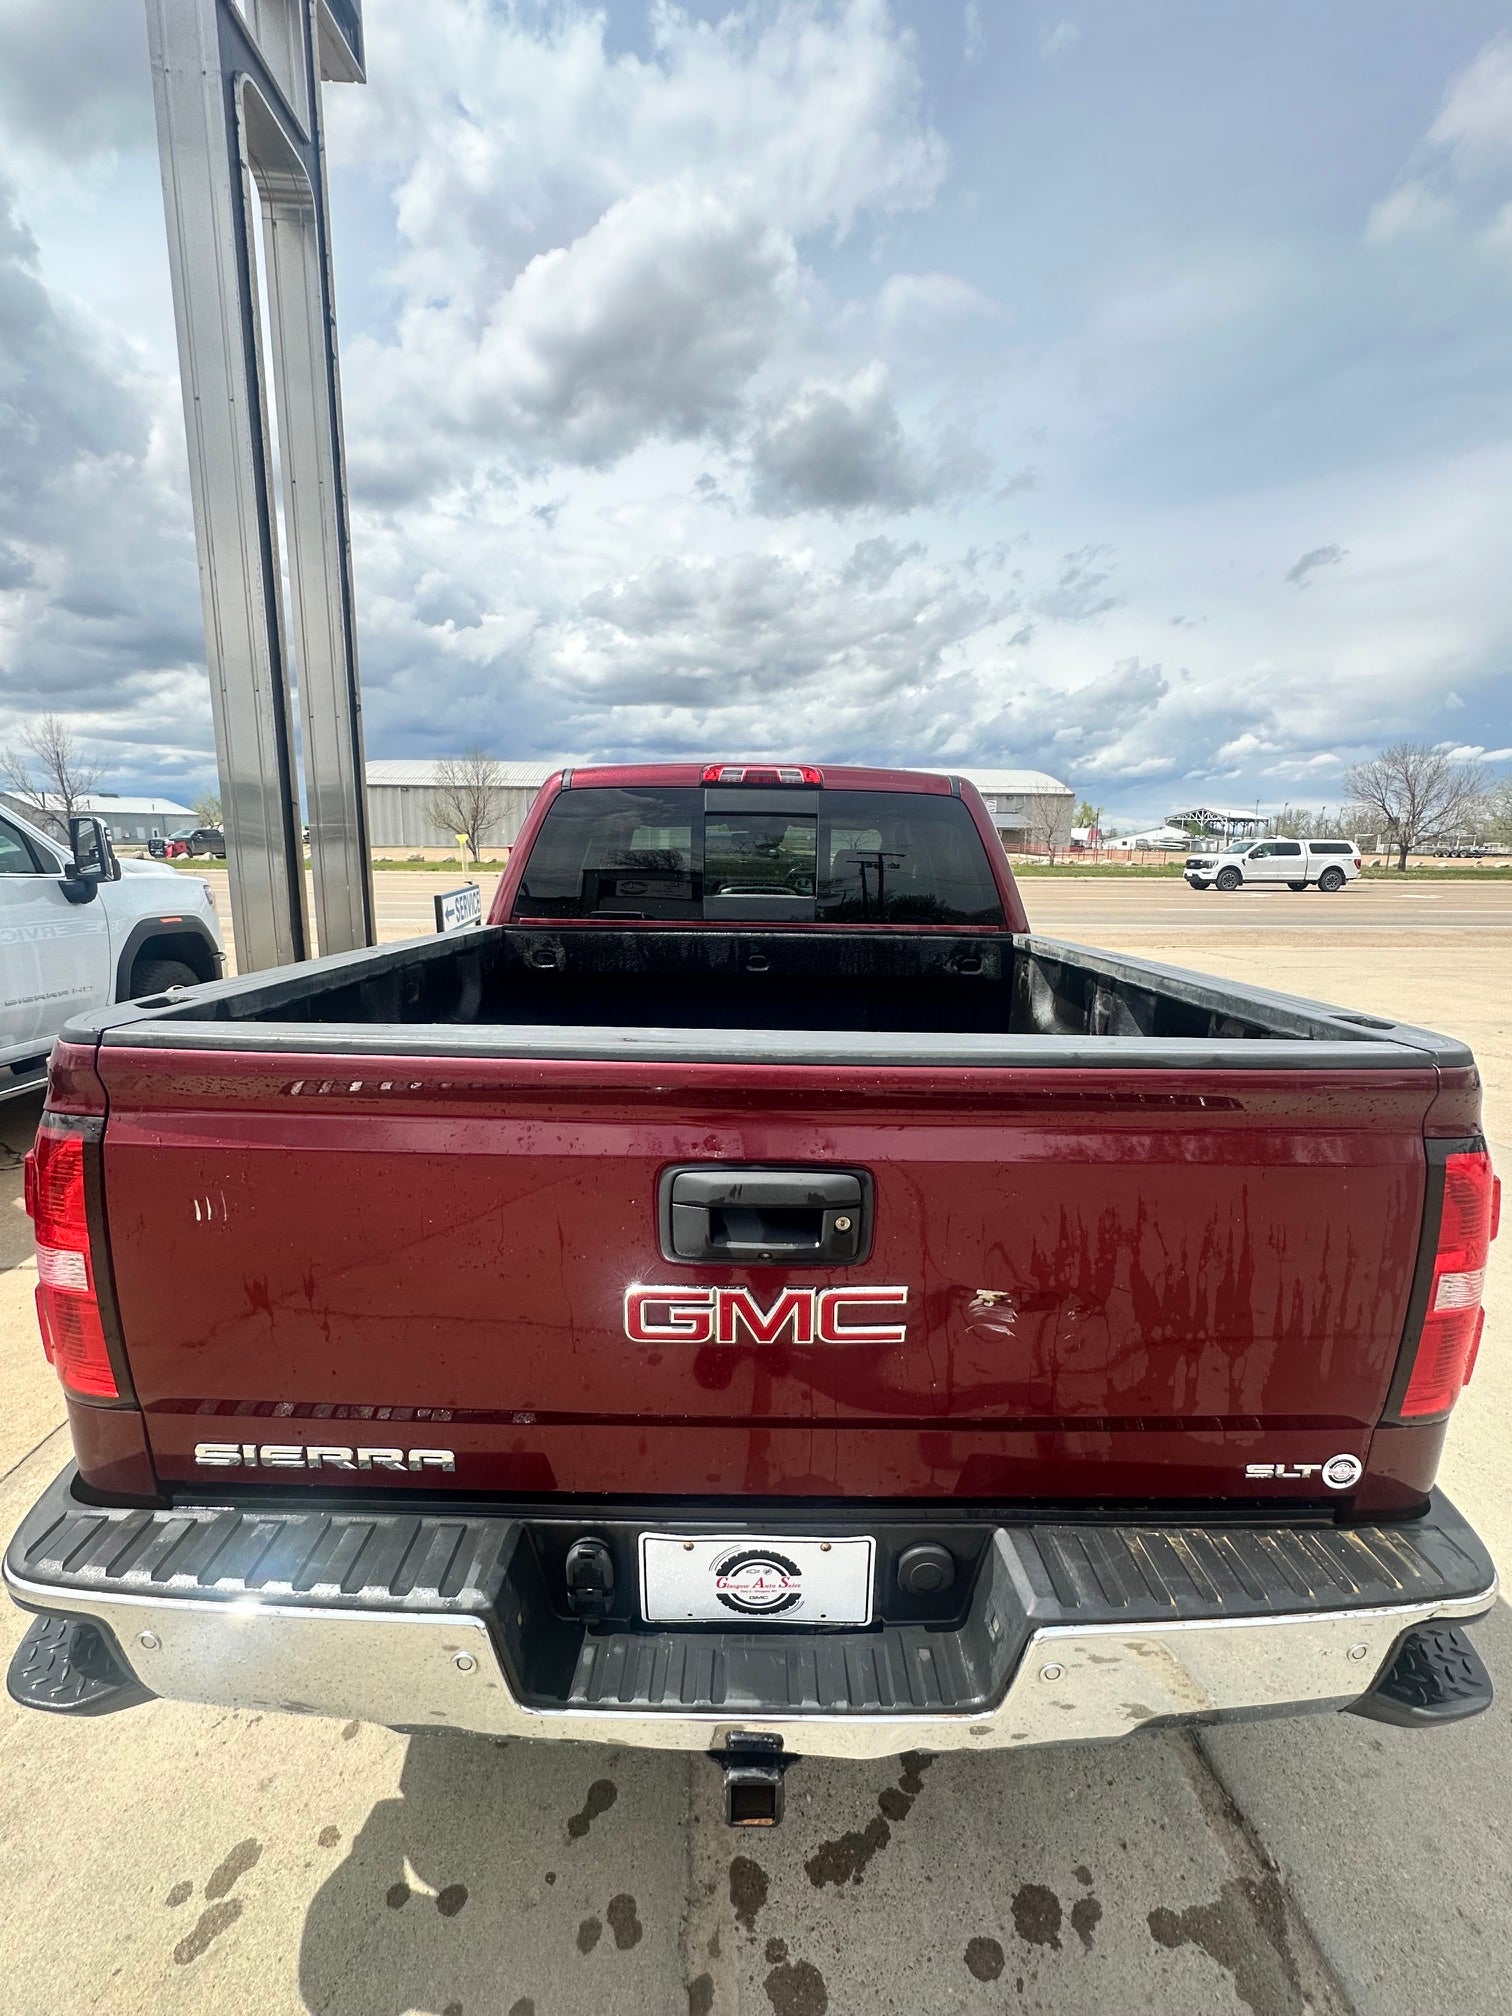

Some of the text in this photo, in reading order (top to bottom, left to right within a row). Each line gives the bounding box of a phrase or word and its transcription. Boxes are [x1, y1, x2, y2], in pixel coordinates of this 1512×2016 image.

[455, 891, 480, 922] SERVICE
[624, 1285, 909, 1343] GMC
[195, 1443, 456, 1472] SIERRA
[1245, 1464, 1322, 1478] SLT
[716, 1576, 801, 1590] Glasgow Auto Sales
